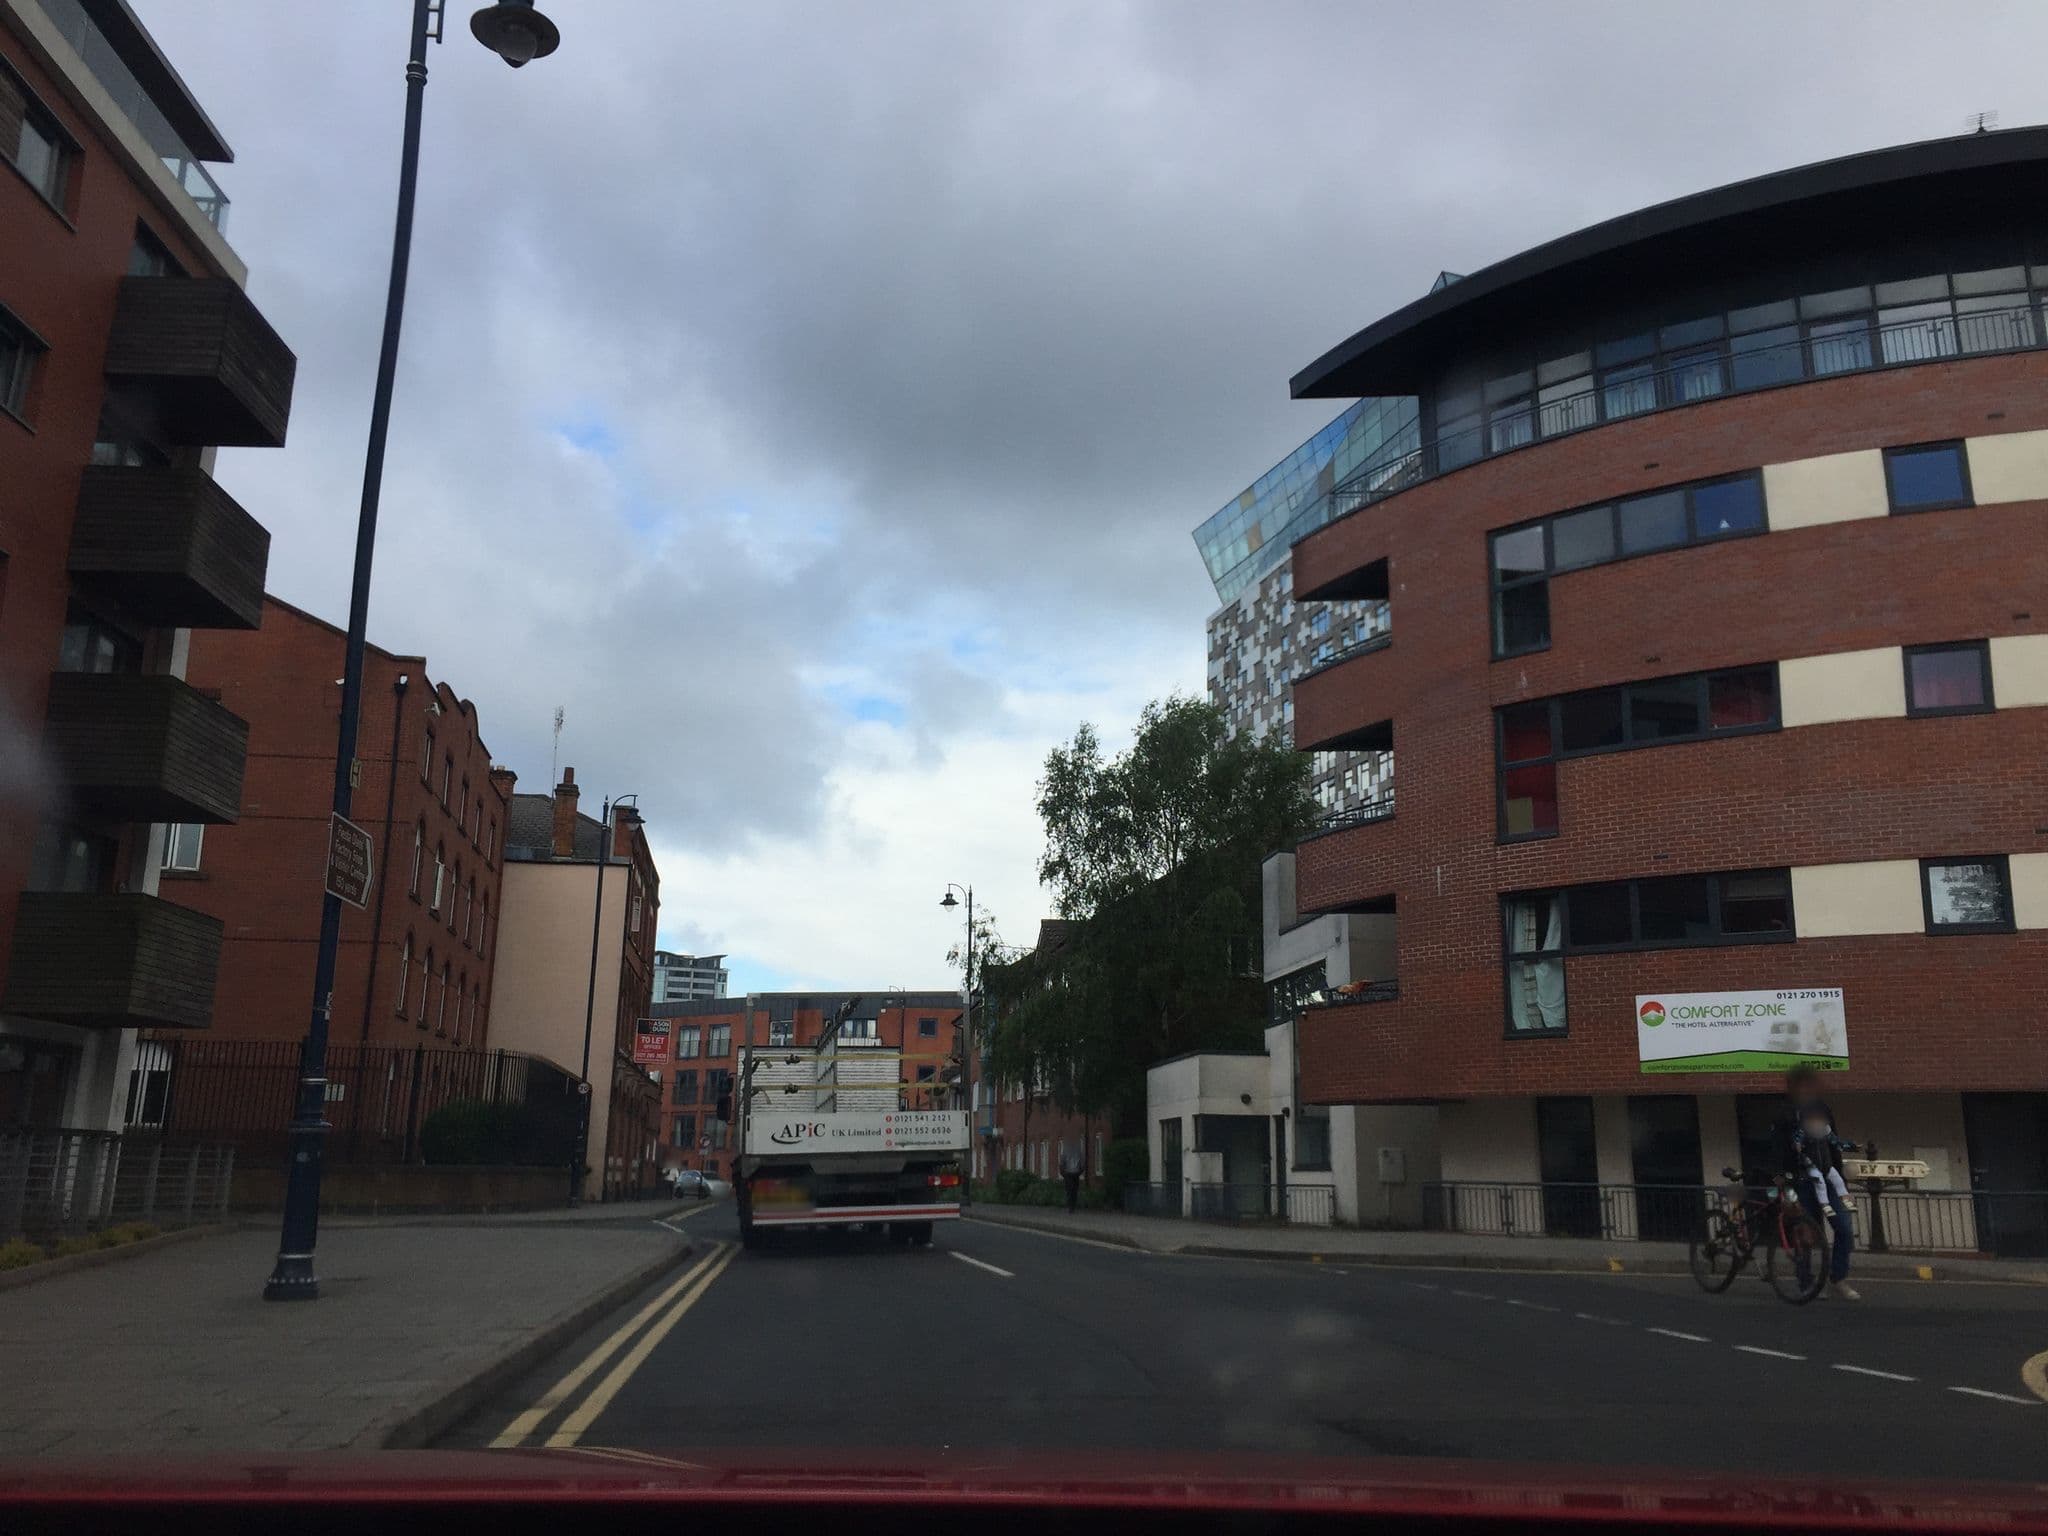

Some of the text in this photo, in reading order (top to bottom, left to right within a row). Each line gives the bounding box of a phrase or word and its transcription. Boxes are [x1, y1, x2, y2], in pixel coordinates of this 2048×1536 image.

[1776, 990, 1840, 1000] 0121 270 1915
[1670, 1003, 1787, 1020] COMFORT ZONE
[1687, 1020, 1708, 1029] HOTEL
[641, 1036, 665, 1045] TO LET
[894, 1114, 952, 1123] 0121 541 2121
[780, 1121, 882, 1138] APiC UK Limited
[894, 1127, 912, 1135] 0121
[914, 1127, 929, 1135] 552
[1887, 1165, 1905, 1175] ST
